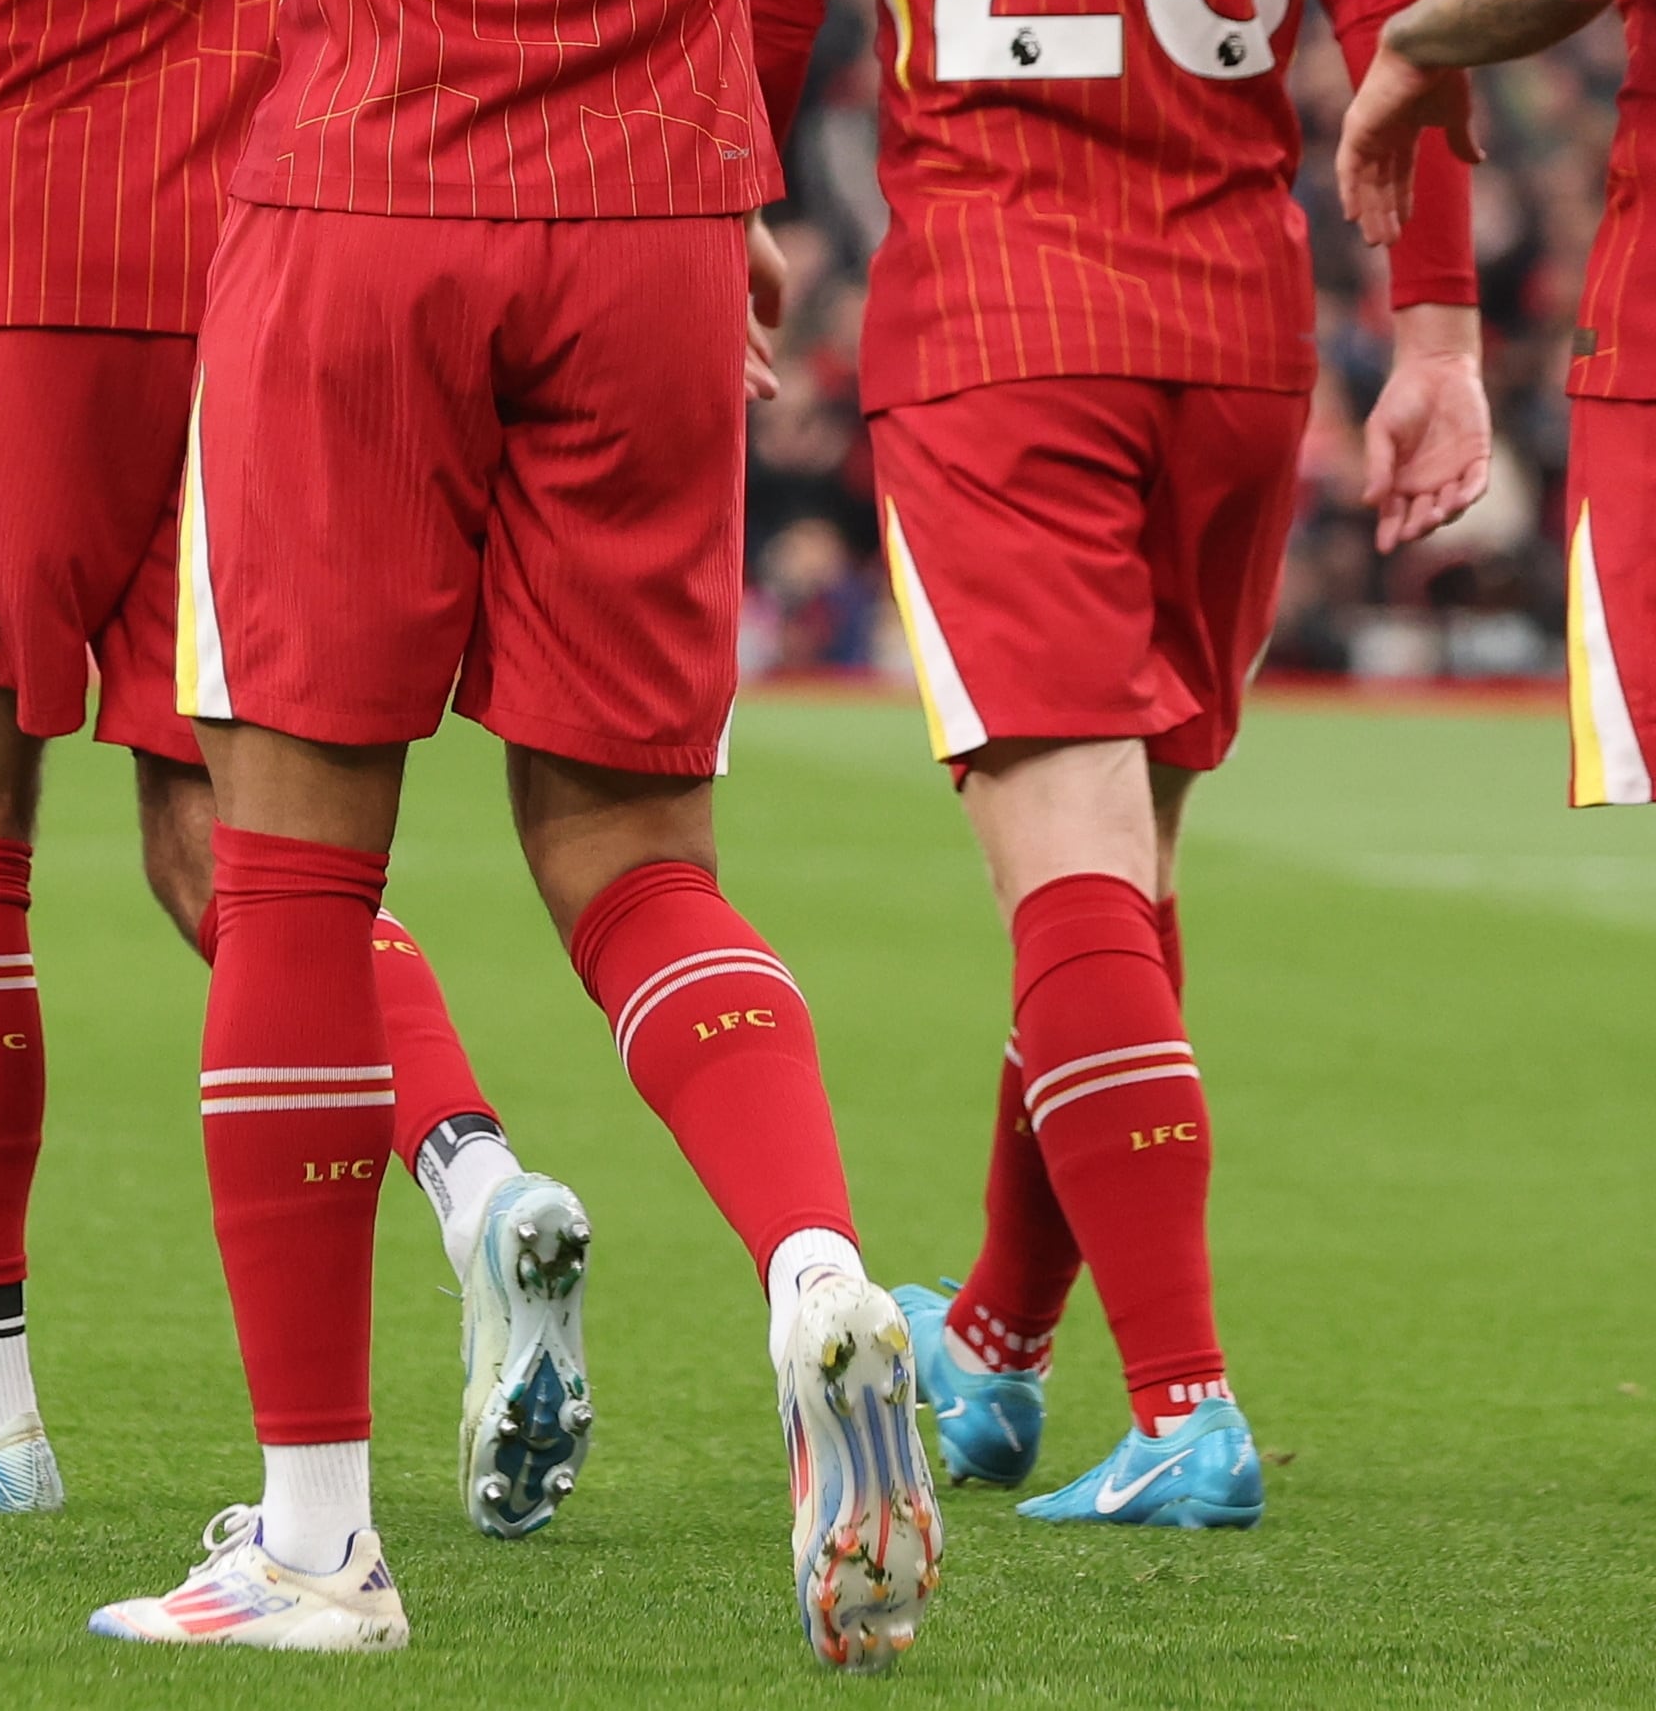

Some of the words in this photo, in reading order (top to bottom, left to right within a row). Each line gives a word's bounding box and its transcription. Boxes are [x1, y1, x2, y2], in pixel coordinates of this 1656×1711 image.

[371, 939, 420, 958] FC
[692, 1008, 777, 1043] LFC
[1129, 1121, 1199, 1152] LFC
[302, 1158, 374, 1183] LFC
